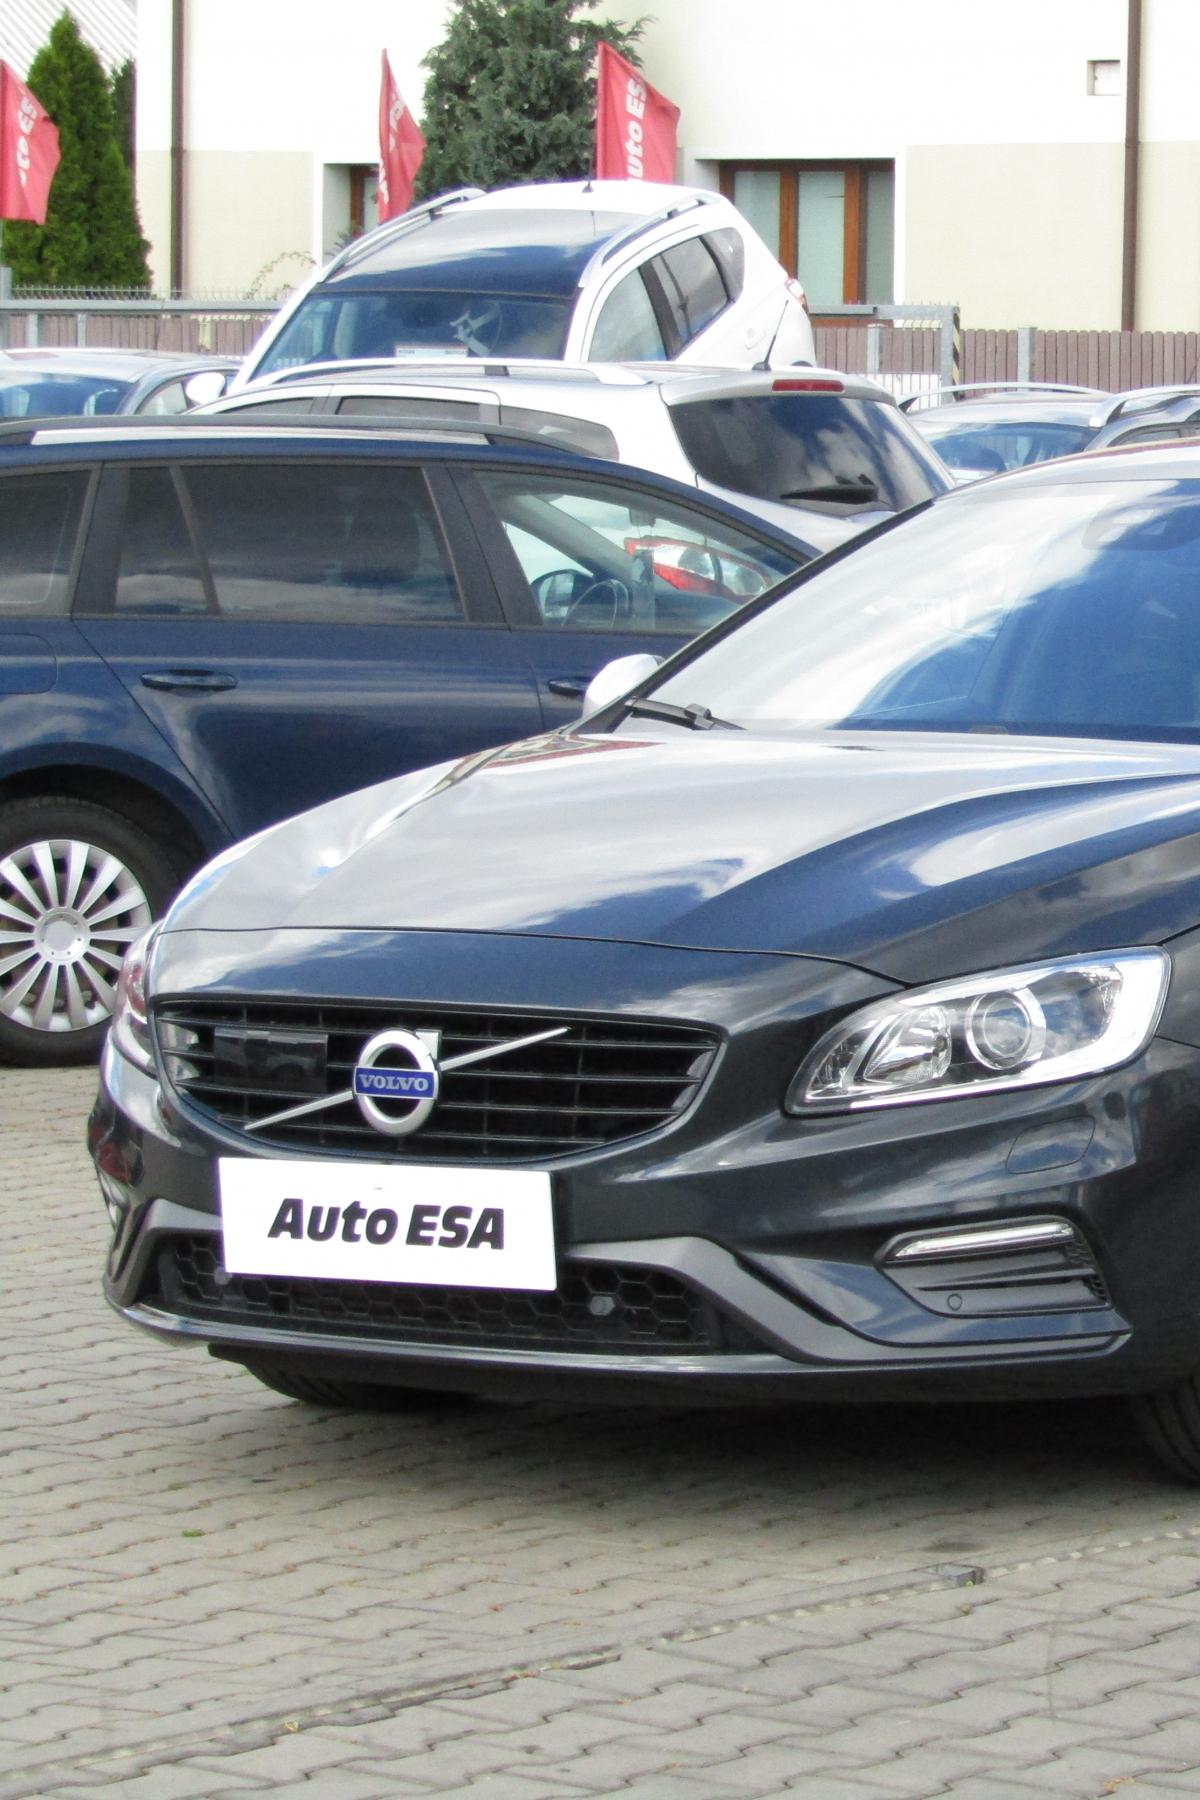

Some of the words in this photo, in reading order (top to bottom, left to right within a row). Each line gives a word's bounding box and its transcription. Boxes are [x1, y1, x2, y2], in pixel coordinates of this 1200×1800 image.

[625, 78, 647, 120] ES
[625, 120, 643, 180] uto
[358, 1073, 430, 1092] VOLVO
[267, 1198, 399, 1245] Auto
[405, 1204, 505, 1250] ESA
